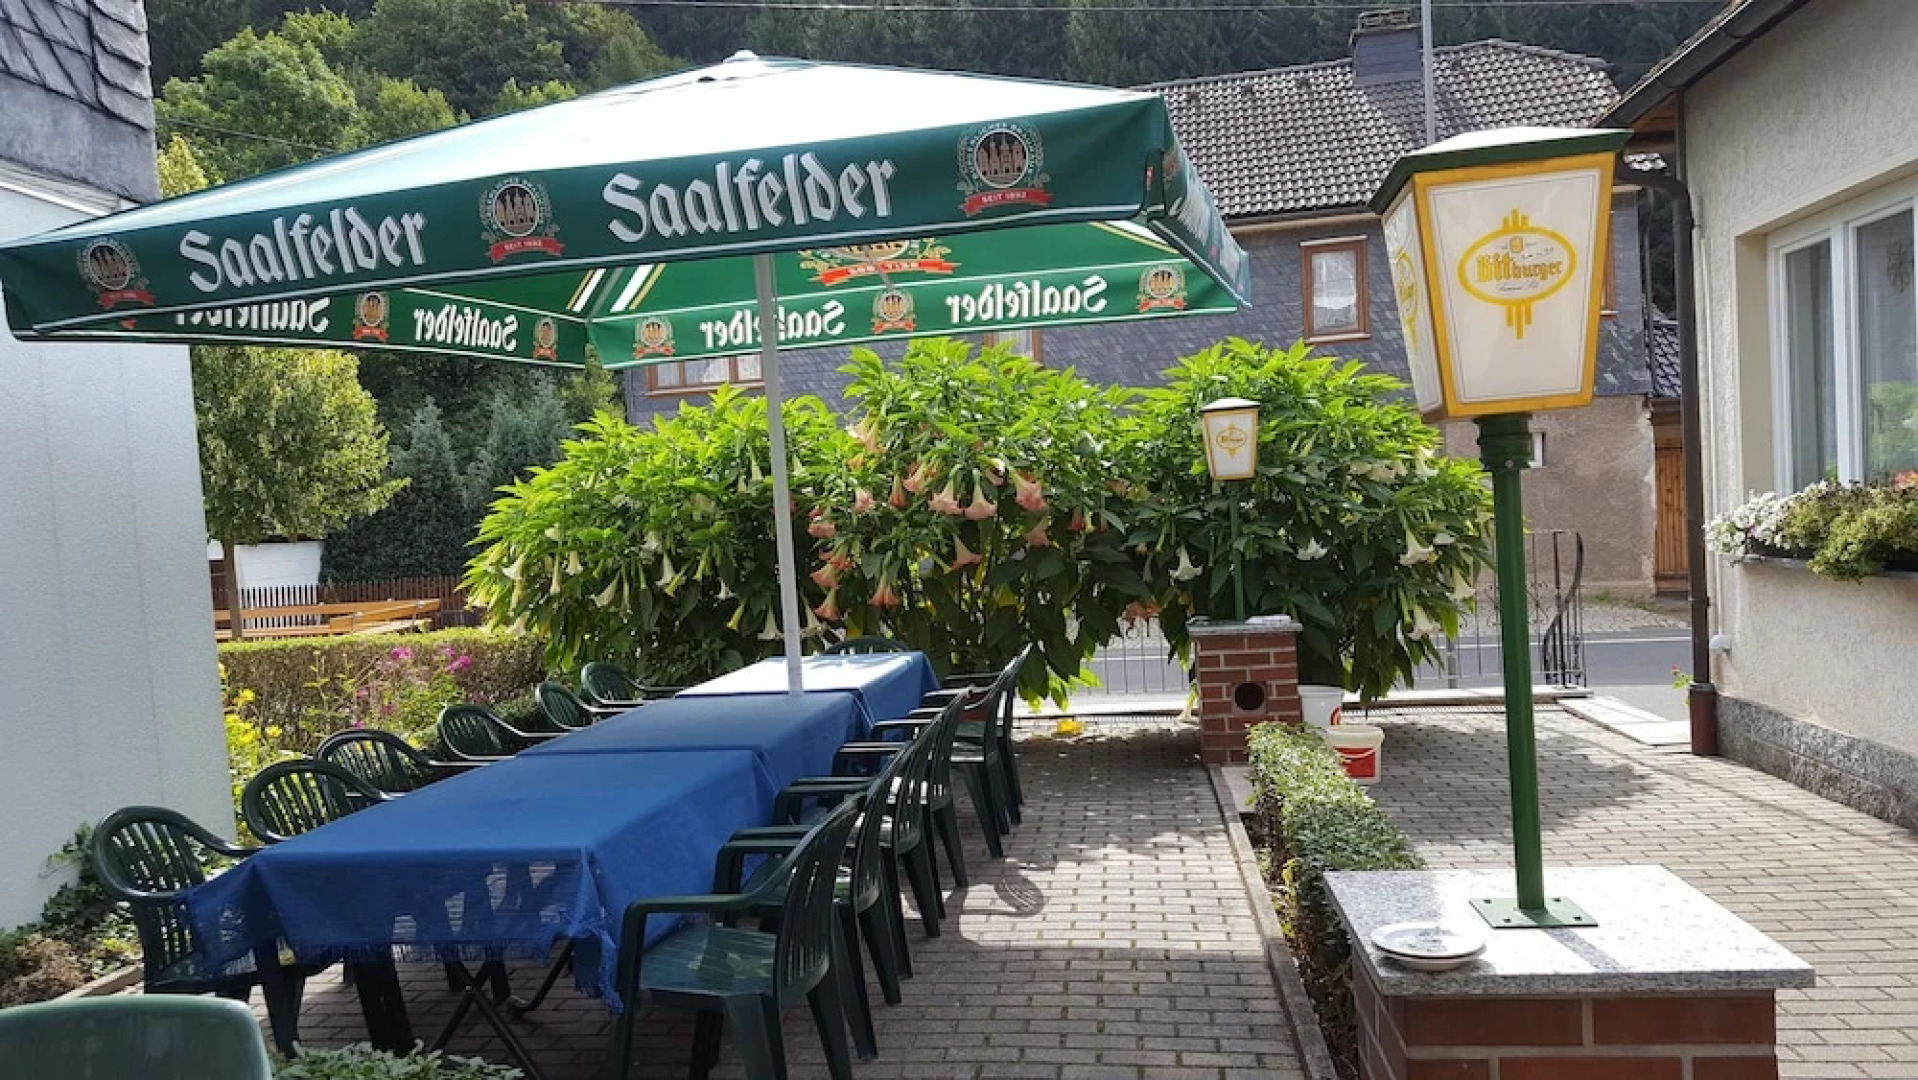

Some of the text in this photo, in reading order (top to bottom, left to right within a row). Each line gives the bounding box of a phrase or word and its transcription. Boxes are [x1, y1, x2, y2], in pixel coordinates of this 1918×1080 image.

[602, 152, 896, 244] Saalfelder
[178, 206, 426, 293] Saalfelder
[1476, 253, 1562, 282] Bitburger
